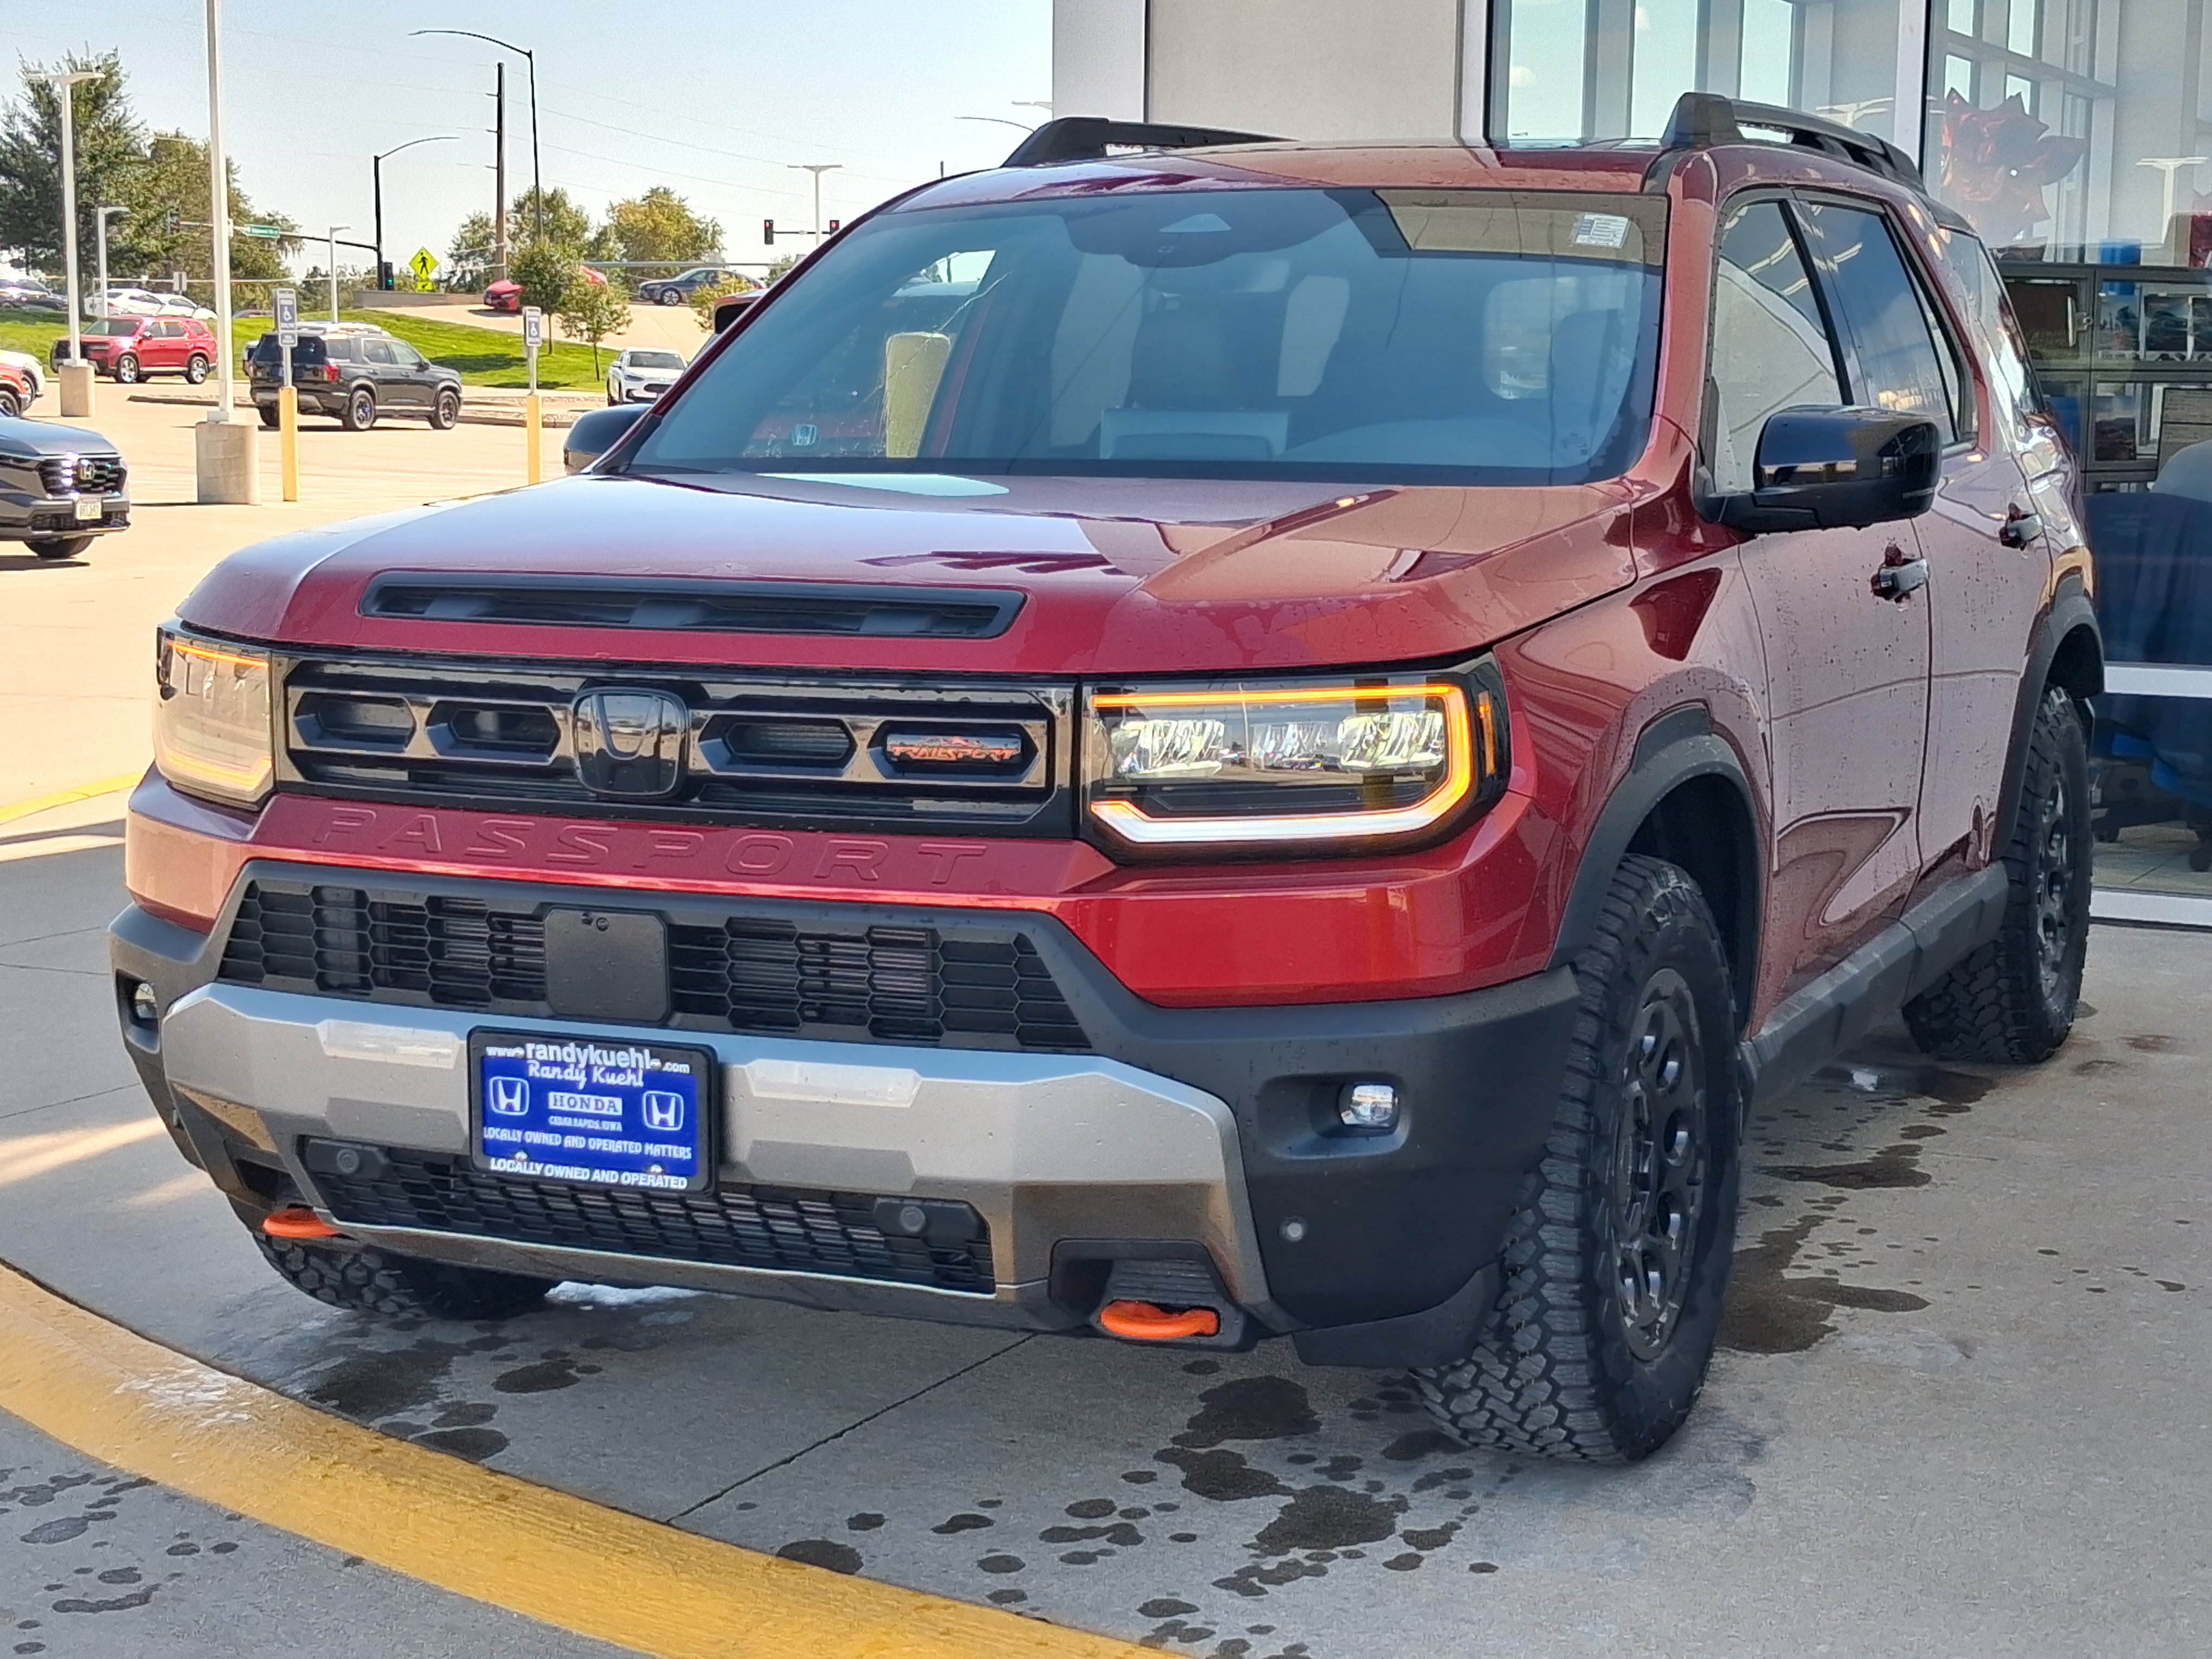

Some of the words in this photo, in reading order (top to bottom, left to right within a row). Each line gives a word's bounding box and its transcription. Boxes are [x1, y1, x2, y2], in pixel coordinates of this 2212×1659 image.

[891, 746, 1021, 762] TRAILSPORT
[312, 807, 988, 885] PASSPORT
[486, 1042, 690, 1074] wwwrandykuehl.com
[526, 1059, 587, 1090] Randy
[593, 1066, 644, 1088] Kuehl
[553, 1095, 619, 1113] HONDA
[484, 1127, 523, 1142] LOCALLY
[524, 1131, 562, 1146] OWNED
[563, 1136, 586, 1148] AND
[588, 1137, 642, 1154] OPERATED
[645, 1142, 692, 1160] MATTERS
[490, 1158, 543, 1175] LOCALLY
[544, 1163, 590, 1180] OWNED
[591, 1169, 619, 1184] AND
[621, 1171, 688, 1190] OPERATED
